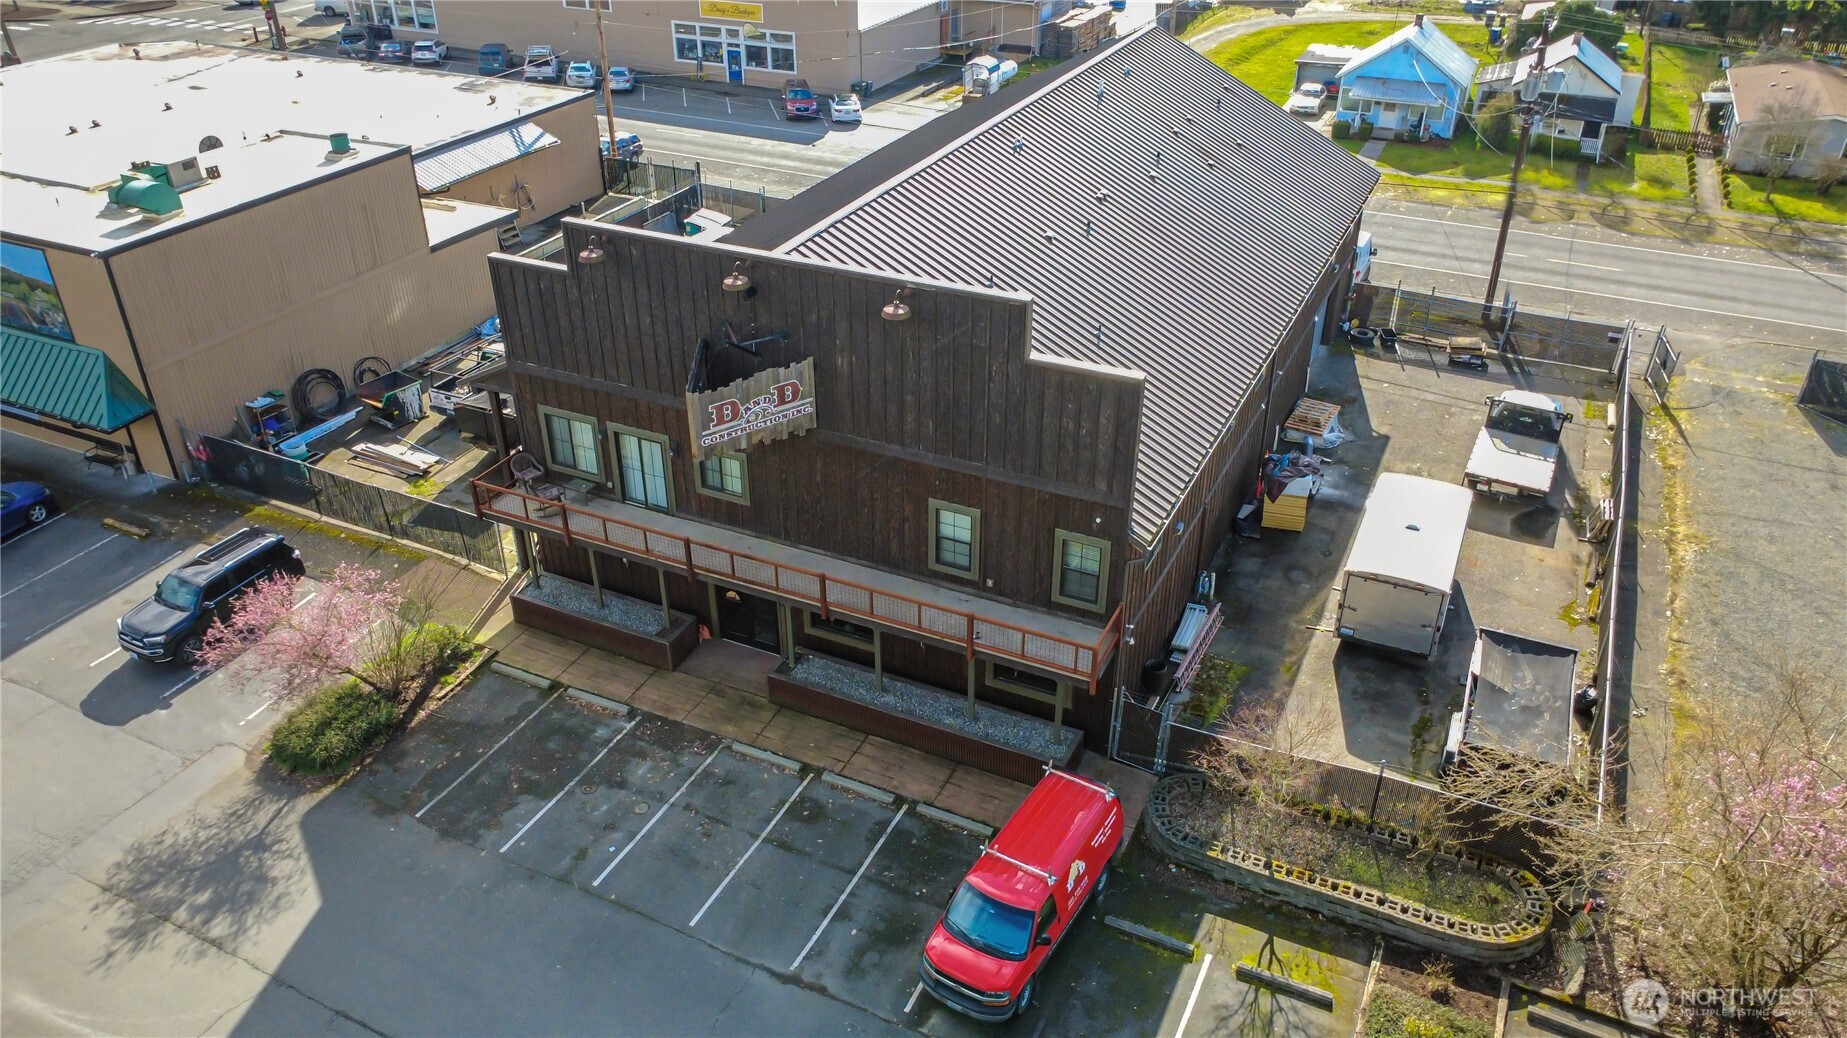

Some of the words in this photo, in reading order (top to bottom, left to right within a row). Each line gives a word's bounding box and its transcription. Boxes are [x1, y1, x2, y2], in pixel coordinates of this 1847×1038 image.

[701, 413, 790, 446] CONSTRUCTION
[790, 404, 814, 420] INC.
[709, 399, 742, 430] D
[743, 395, 772, 418] AND
[771, 380, 803, 409] D
